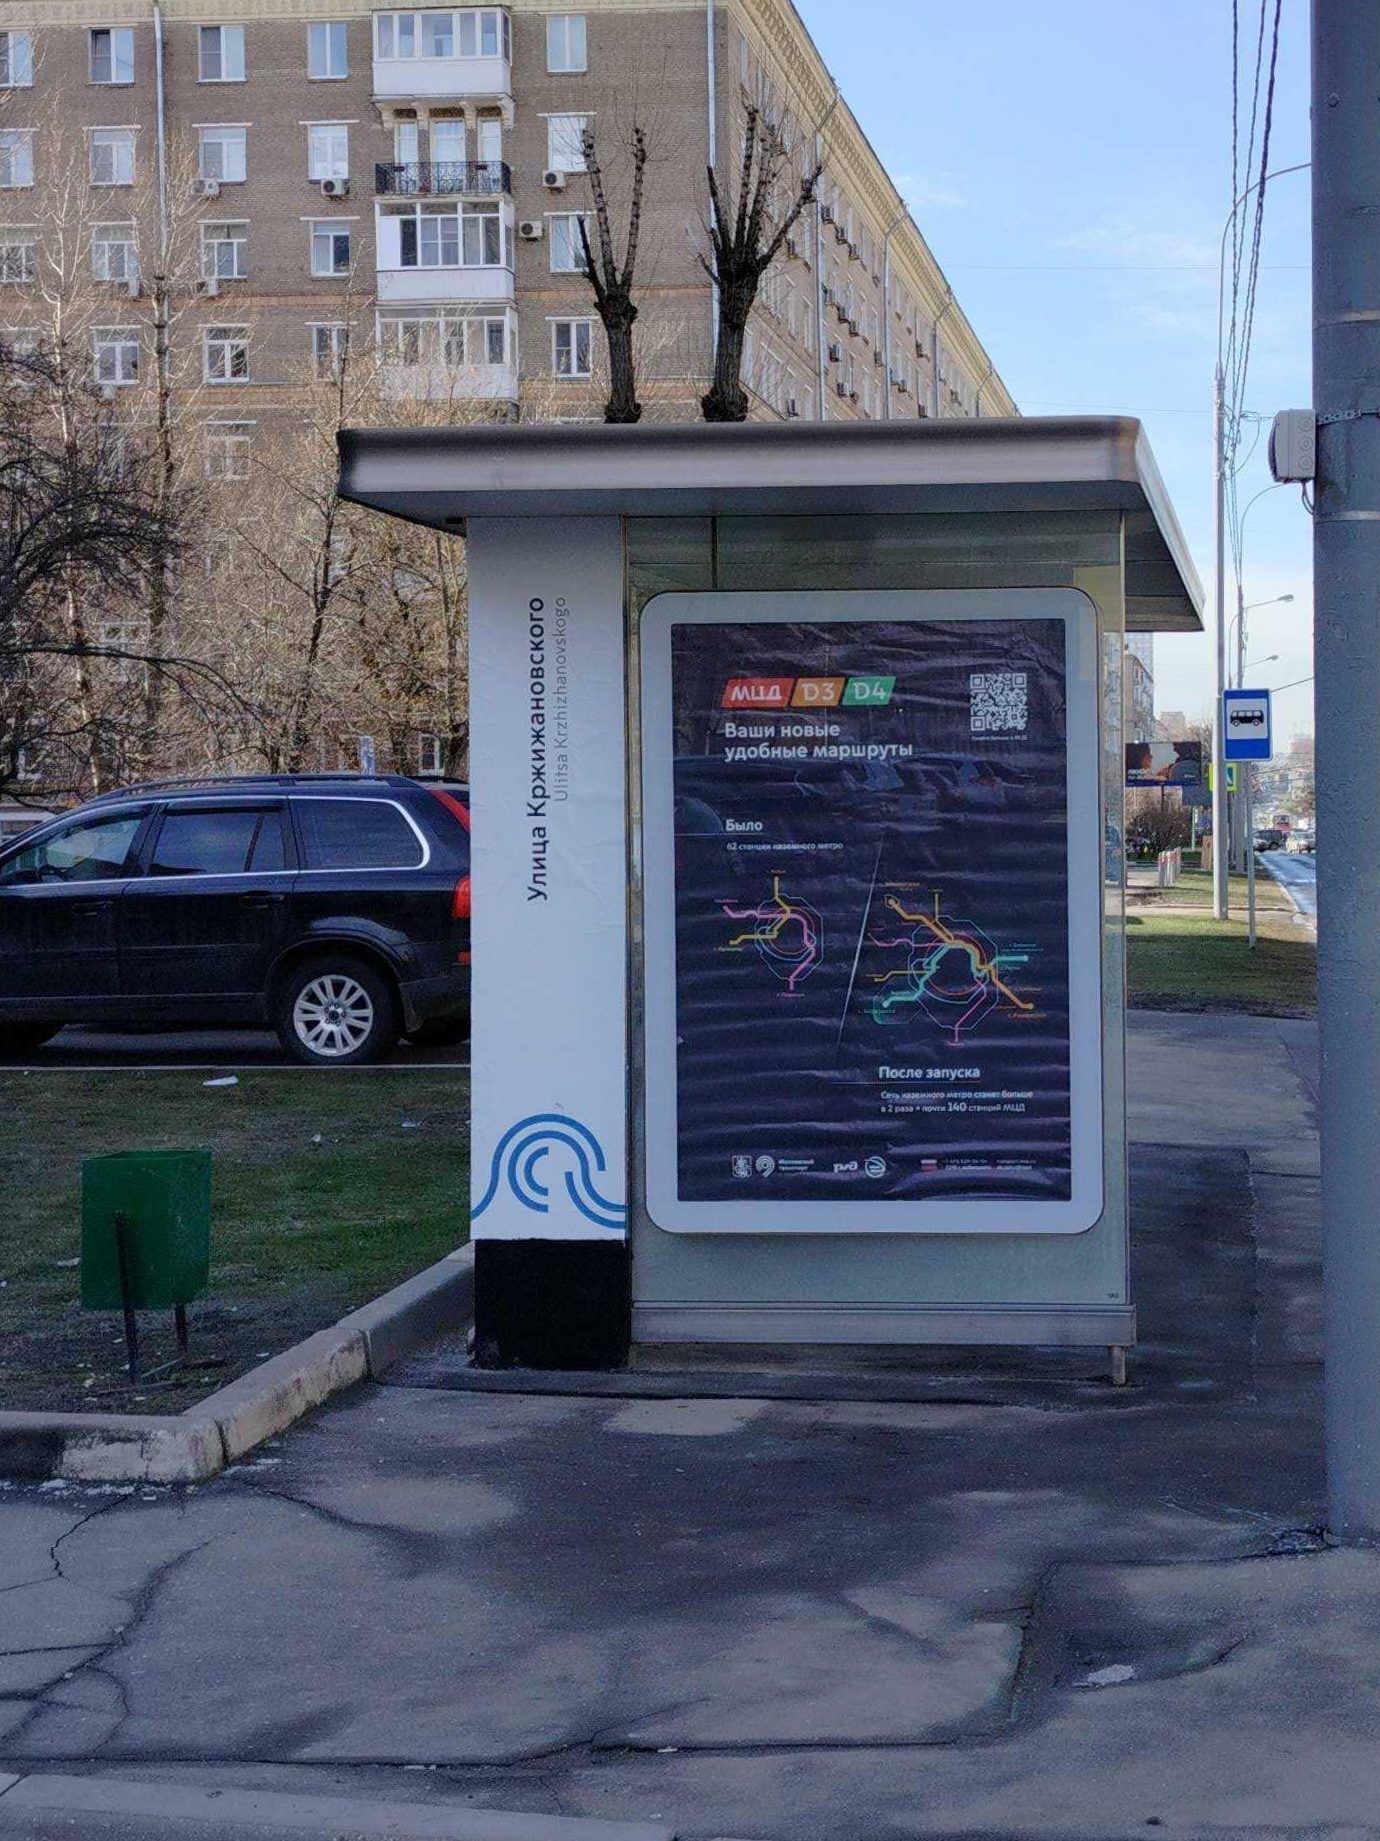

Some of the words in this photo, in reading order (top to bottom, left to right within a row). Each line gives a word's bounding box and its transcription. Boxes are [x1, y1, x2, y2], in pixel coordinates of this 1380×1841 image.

[551, 597, 569, 748] Krzhizhanovskogo
[731, 685, 782, 701] МЦД
[802, 682, 835, 701] D3
[853, 682, 886, 700] D4
[527, 597, 550, 817] Кржижановского
[725, 723, 775, 738] Ваши
[781, 723, 841, 738] новые
[725, 742, 808, 763] удобные
[813, 744, 913, 761] маршруты
[554, 753, 568, 801] Ulitsa
[725, 819, 763, 832] Было
[527, 826, 549, 901] Улица
[879, 1066, 923, 1079] После
[926, 1067, 980, 1081] запуска
[948, 1102, 967, 1112] 140
